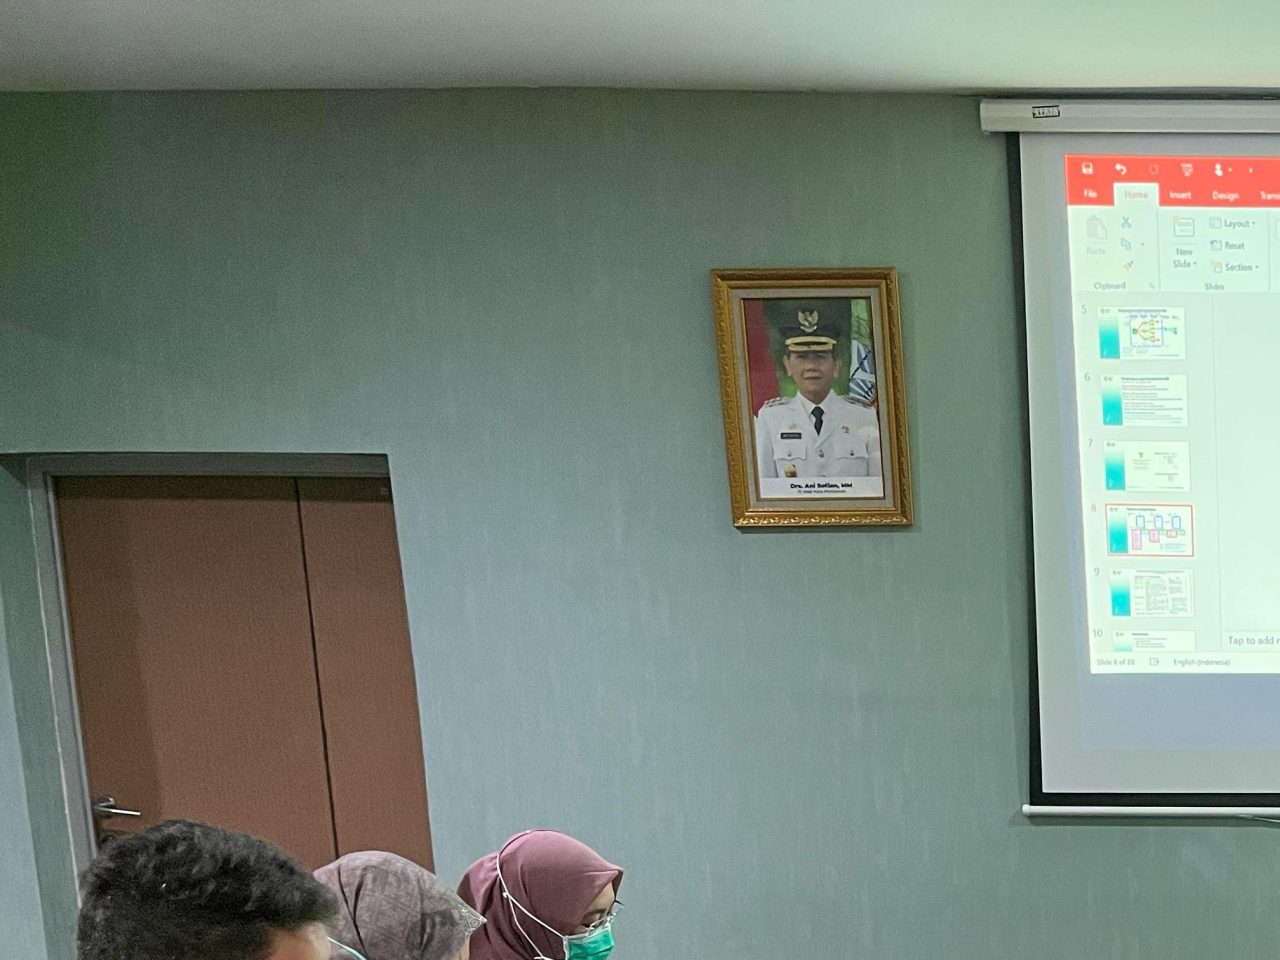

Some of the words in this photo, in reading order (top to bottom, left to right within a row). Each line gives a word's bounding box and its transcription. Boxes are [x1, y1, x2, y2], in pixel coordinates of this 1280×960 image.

[1083, 189, 1097, 199] File
[1124, 190, 1148, 199] Home
[1169, 190, 1191, 200] Insert
[1212, 191, 1239, 201] Design
[1224, 219, 1250, 229] Layout
[1225, 241, 1245, 250] Reset
[1176, 248, 1193, 257] New
[1173, 259, 1191, 268] Slide
[1225, 263, 1253, 272] Section
[1094, 282, 1127, 291] Clipboard
[1205, 283, 1224, 291] Slides
[1081, 305, 1087, 313] 5
[1084, 372, 1090, 381] 6
[1088, 439, 1093, 447] 7
[1091, 504, 1097, 512] 8
[1094, 568, 1100, 576] 9
[1093, 629, 1103, 637] 10
[1228, 636, 1244, 646] Tap
[1246, 637, 1255, 645] to
[1257, 636, 1274, 645] add
